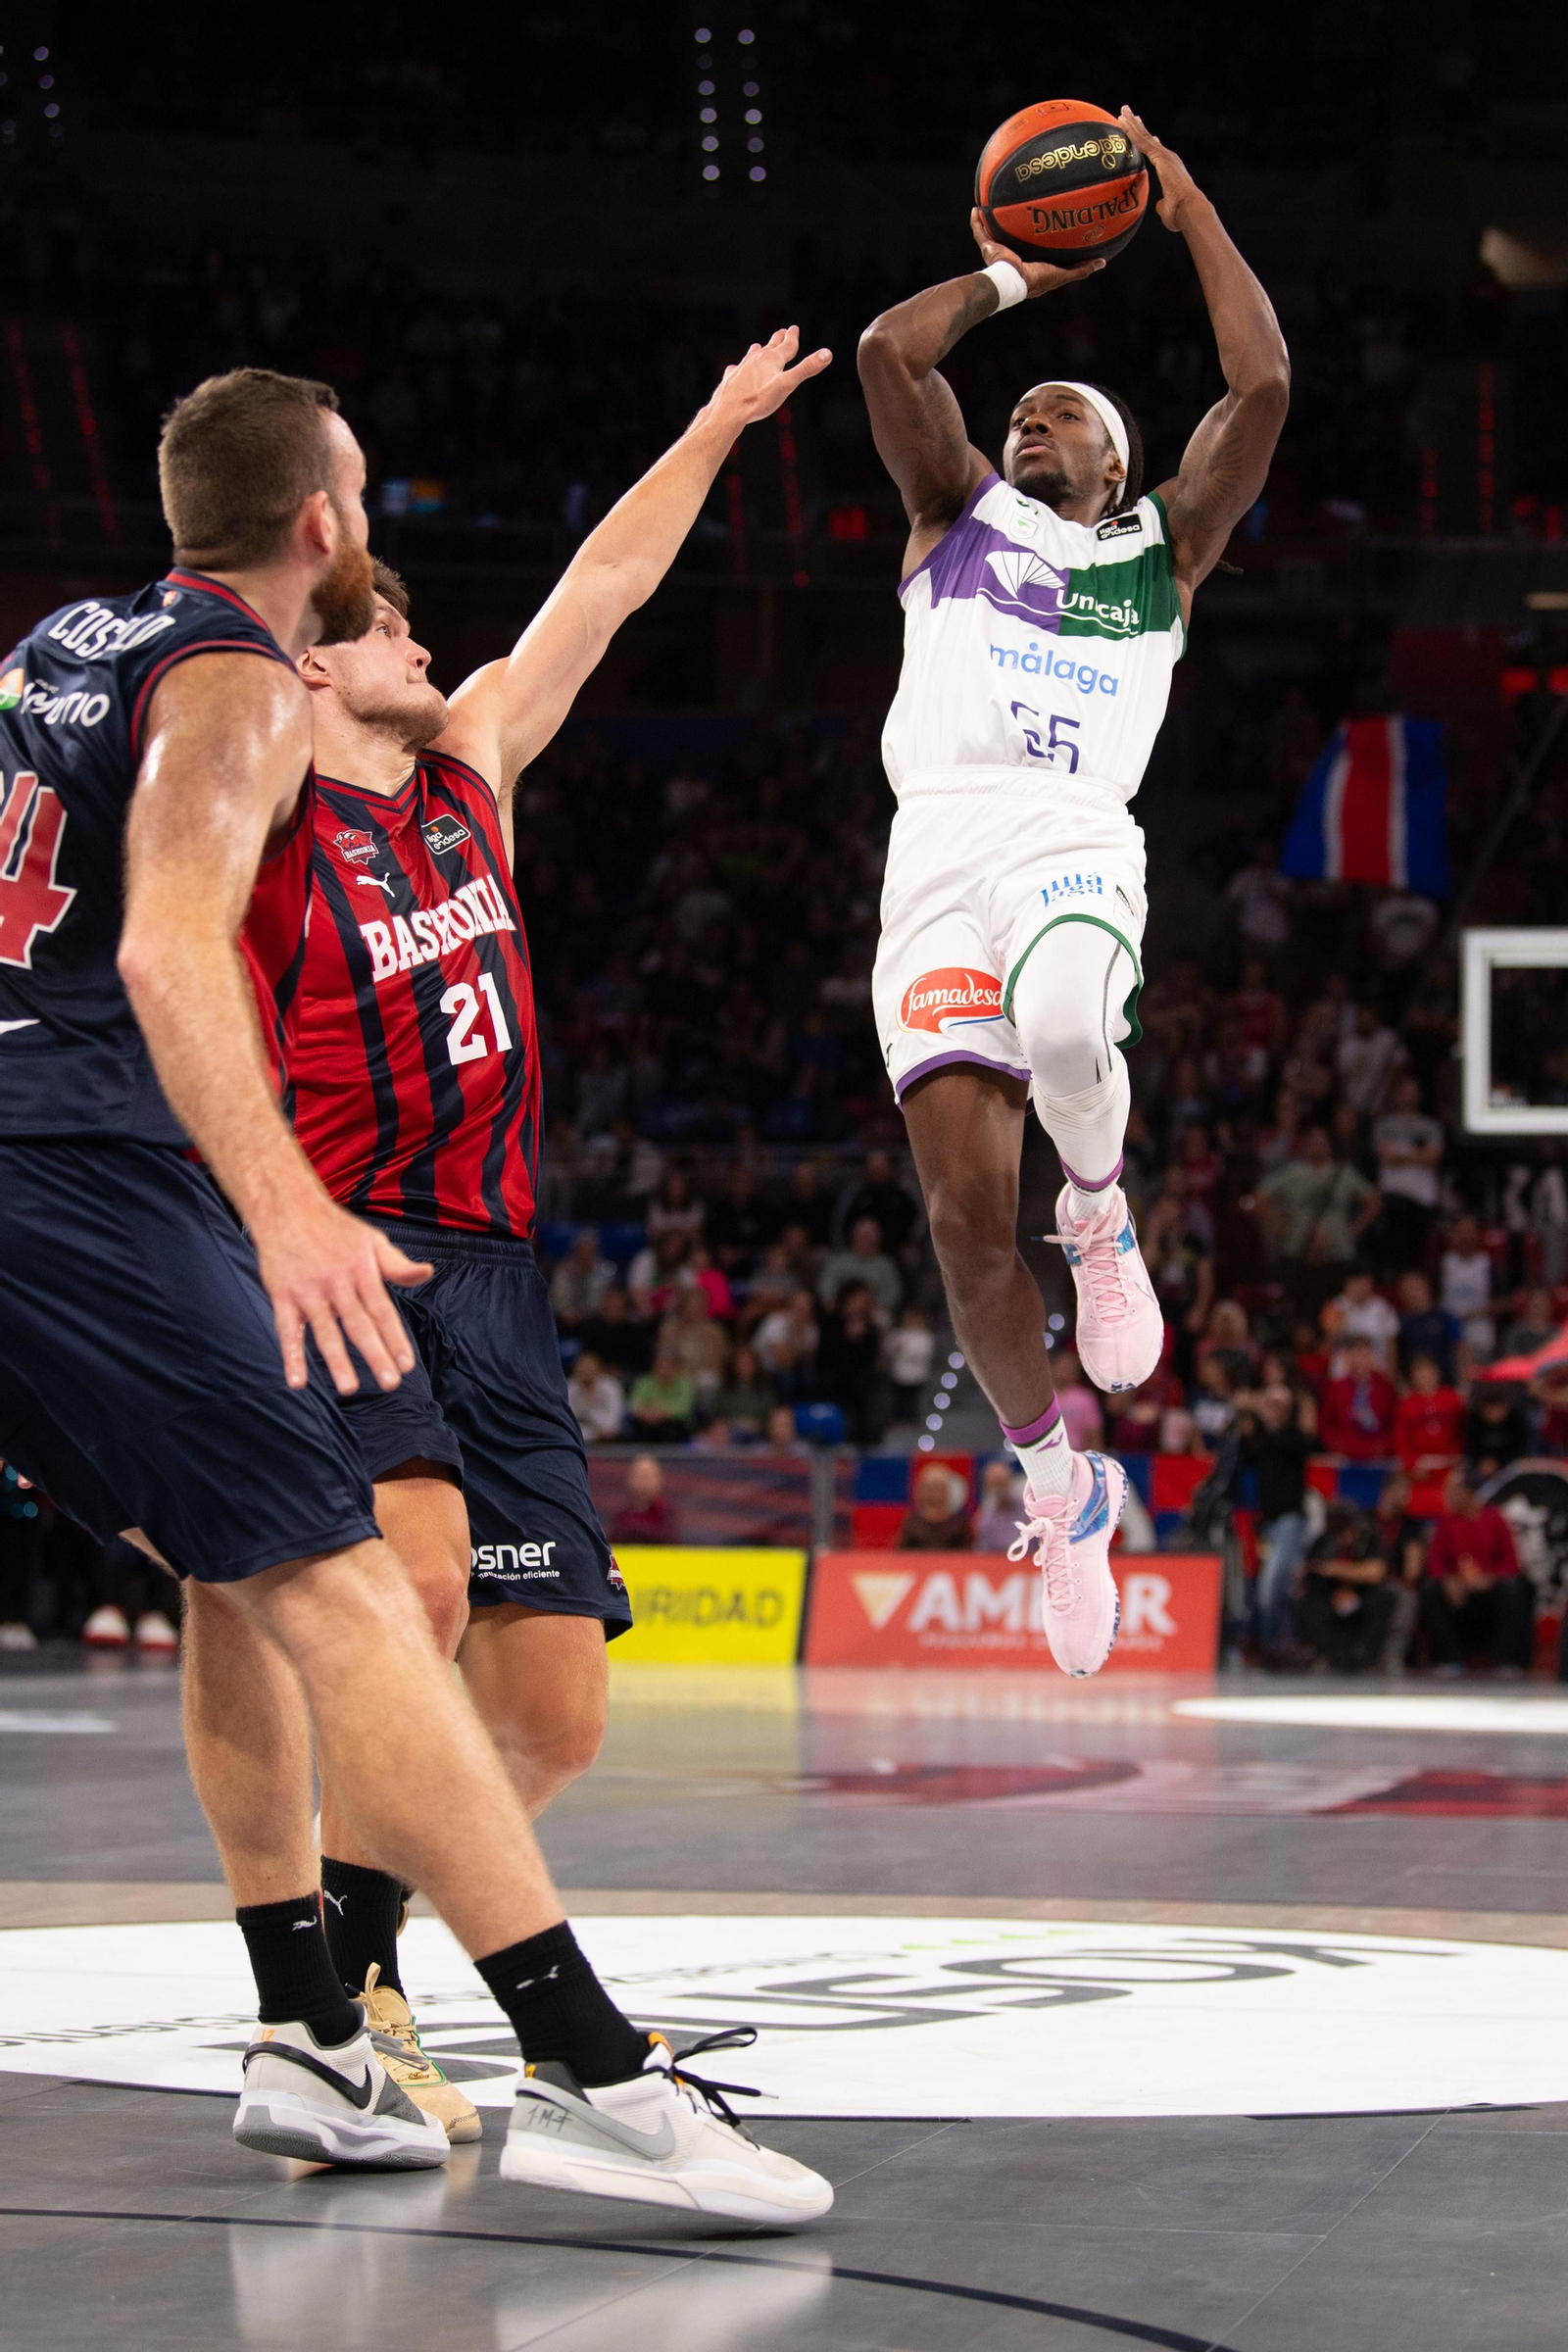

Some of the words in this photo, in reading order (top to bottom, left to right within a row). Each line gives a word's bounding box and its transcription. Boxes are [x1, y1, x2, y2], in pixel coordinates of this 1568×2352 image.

[1014, 139, 1102, 183] endesa
[1032, 181, 1140, 235] SPALDING
[1101, 524, 1141, 539] endesa
[426, 830, 444, 844] liga
[433, 828, 466, 850] endesa
[0, 770, 78, 970] 4
[359, 873, 517, 985] BASKONIA
[440, 972, 513, 1065] 21
[522, 1569, 561, 1581] eficiente
